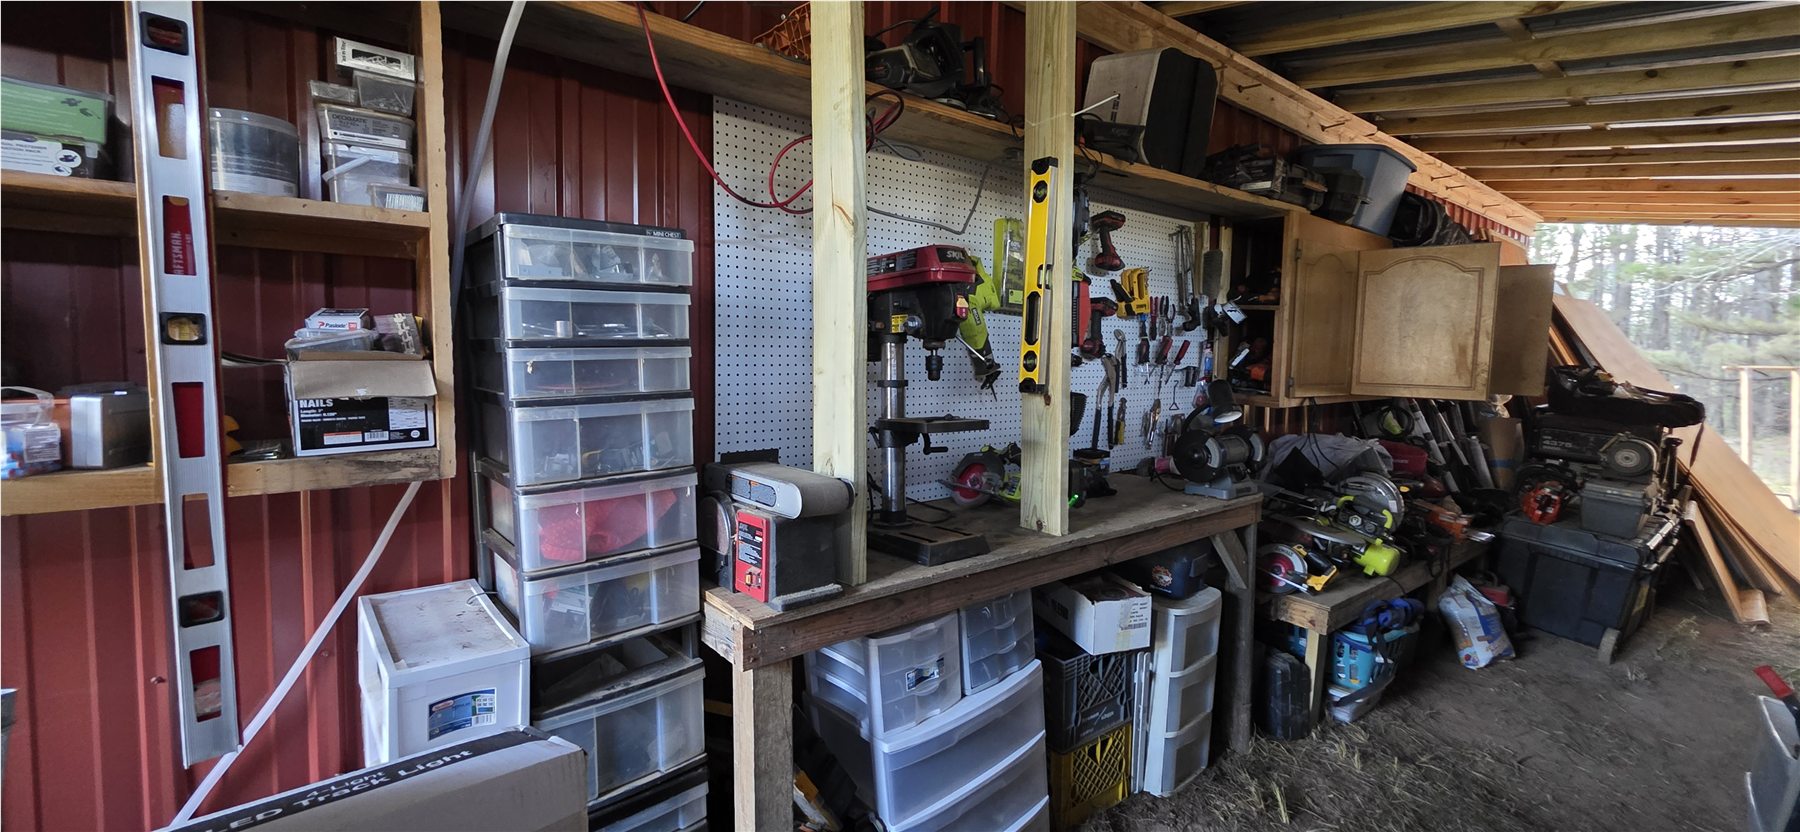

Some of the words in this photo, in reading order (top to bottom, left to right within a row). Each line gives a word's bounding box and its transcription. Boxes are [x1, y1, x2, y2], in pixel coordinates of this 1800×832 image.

[170, 231, 184, 274] AFTSMAN
[946, 250, 965, 260] SKIL
[299, 399, 334, 408] NAILS
[293, 777, 391, 806] Track
[398, 749, 473, 776] Light
[307, 772, 384, 797] 4-Light
